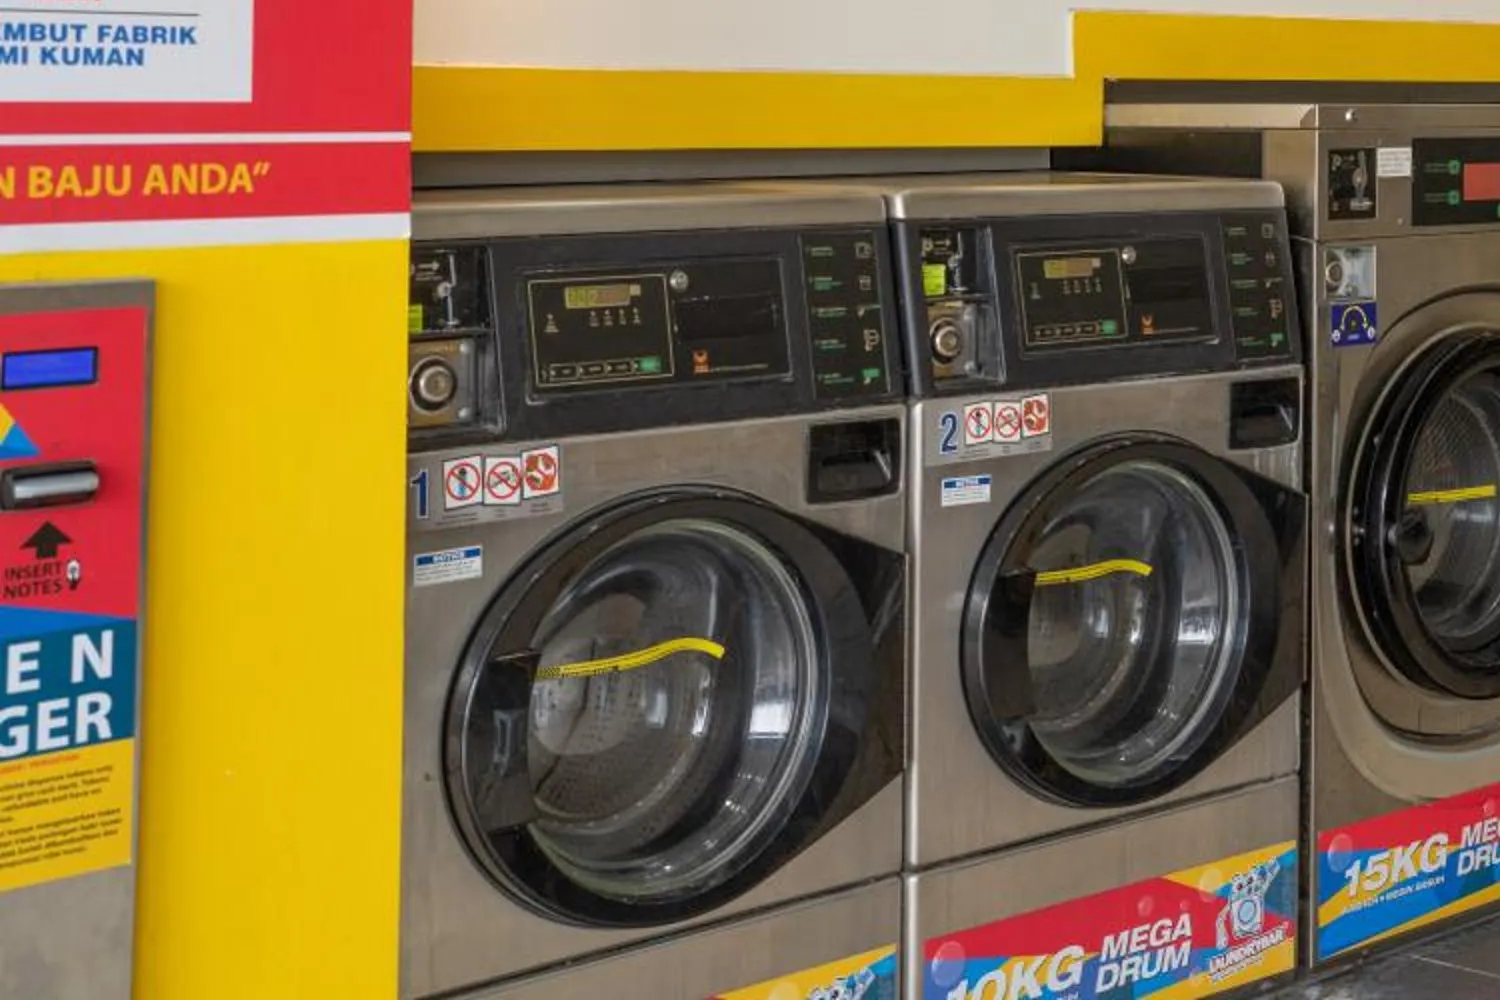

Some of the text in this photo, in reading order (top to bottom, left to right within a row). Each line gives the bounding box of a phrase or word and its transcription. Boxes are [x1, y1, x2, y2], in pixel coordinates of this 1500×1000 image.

[0, 22, 197, 46] MBUT FABRIK
[40, 46, 145, 67] KUMAN
[28, 164, 132, 199] BAJU
[939, 414, 958, 454] 2
[410, 471, 429, 519] 1
[3, 579, 63, 599] NOTES
[4, 561, 62, 583] INSERT
[1344, 832, 1449, 897] 15KG
[1100, 912, 1194, 962] MEGA
[1094, 942, 1193, 994] DRUM
